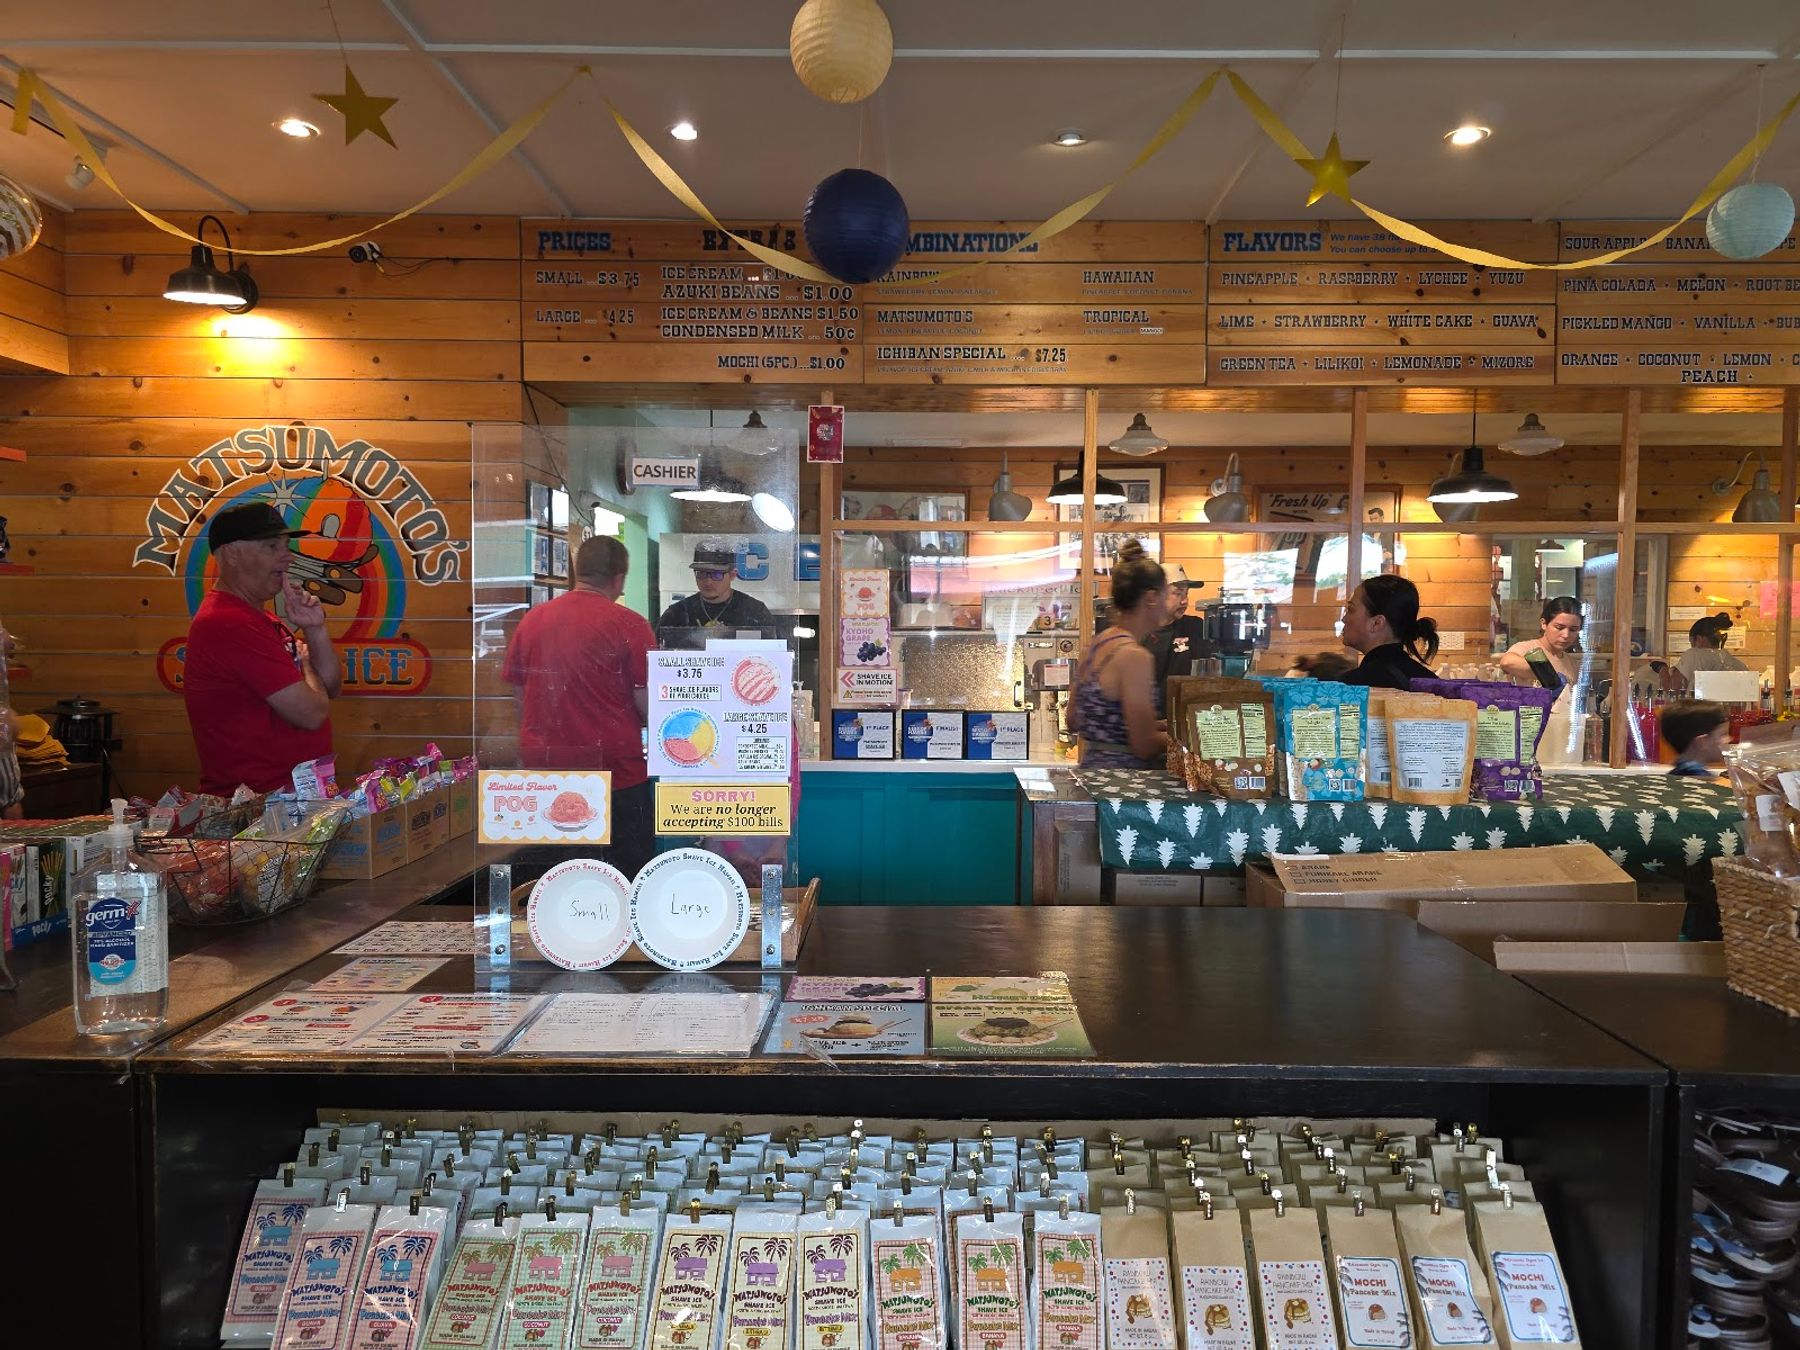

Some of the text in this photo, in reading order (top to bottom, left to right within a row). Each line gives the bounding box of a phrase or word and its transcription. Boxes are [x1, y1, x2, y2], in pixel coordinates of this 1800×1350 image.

[539, 232, 612, 251] PRICES
[1224, 232, 1321, 252] FLAVORS
[1565, 238, 1600, 250] SOUR
[536, 272, 582, 284] SMALL
[662, 266, 686, 280] ICE
[688, 266, 743, 280] CREAM
[1083, 271, 1154, 284] HAWAIIAN
[1222, 272, 1524, 286] PINEAPPLE RASPBERRY LYCHEE YUZU
[662, 285, 854, 300] AZUKI BEANS $1.00
[1601, 280, 1656, 292] COLADA
[1676, 280, 1726, 292] MELON
[1746, 280, 1782, 292] ROOT
[536, 310, 581, 323] LARGE
[662, 308, 859, 320] ICE CREAM & BEANS $1.50
[877, 310, 973, 323] MATSUMOTO'S
[1084, 310, 1149, 323] TROPICAL
[1220, 315, 1537, 328] LIME STRAWBERRY WHITE CAKE GUAVA
[1562, 318, 1618, 330] PICKLED
[1622, 318, 1672, 330] MANGO
[1694, 318, 1756, 330] VANILLA
[662, 325, 759, 338] CONDENSED
[762, 326, 803, 339] MILK
[718, 356, 760, 368] MOCHI
[877, 347, 1067, 364] ICHIBAN SPECIAL $7.25
[1562, 354, 1772, 366] ORANGE COCONUT LEMON
[1220, 357, 1534, 370] GREEN TEA LILIKOI LEMONADE MIZORE
[1681, 370, 1738, 383] PEACH
[633, 465, 696, 479] CASHIER
[133, 425, 470, 585] MATSUMOTO'S
[344, 648, 412, 686] ICE
[677, 668, 702, 679] $3.75
[662, 685, 668, 699] 3
[742, 724, 768, 734] $4.25
[488, 782, 558, 791] Limited Flavor
[692, 791, 756, 802] SORRY!
[494, 796, 537, 812] POG
[670, 803, 776, 817] We are no longer
[664, 815, 783, 829] accepting $100 bills
[570, 899, 610, 921] Small
[672, 892, 711, 919] Large
[1354, 1279, 1386, 1287] MOCHI
[1428, 1279, 1456, 1288] MOCHI
[1512, 1274, 1545, 1282] MOCHI
[290, 1284, 348, 1297] MATSUMOTO'S
[447, 1284, 498, 1298] MATSUMOTO'S
[514, 1284, 571, 1298] MATSUMOTO'S
[588, 1280, 641, 1295] MATSUMOTO'S
[662, 1284, 716, 1300] MATSUMOTO'S
[802, 1286, 859, 1300] MATSUMOTO'S
[734, 1290, 788, 1304] MATSUMOTO'S
[880, 1295, 934, 1309] MATSUMOTO'S
[1042, 1288, 1097, 1302] MATSUMOTO'S
[966, 1296, 1020, 1309] MATSUMOTO'S
